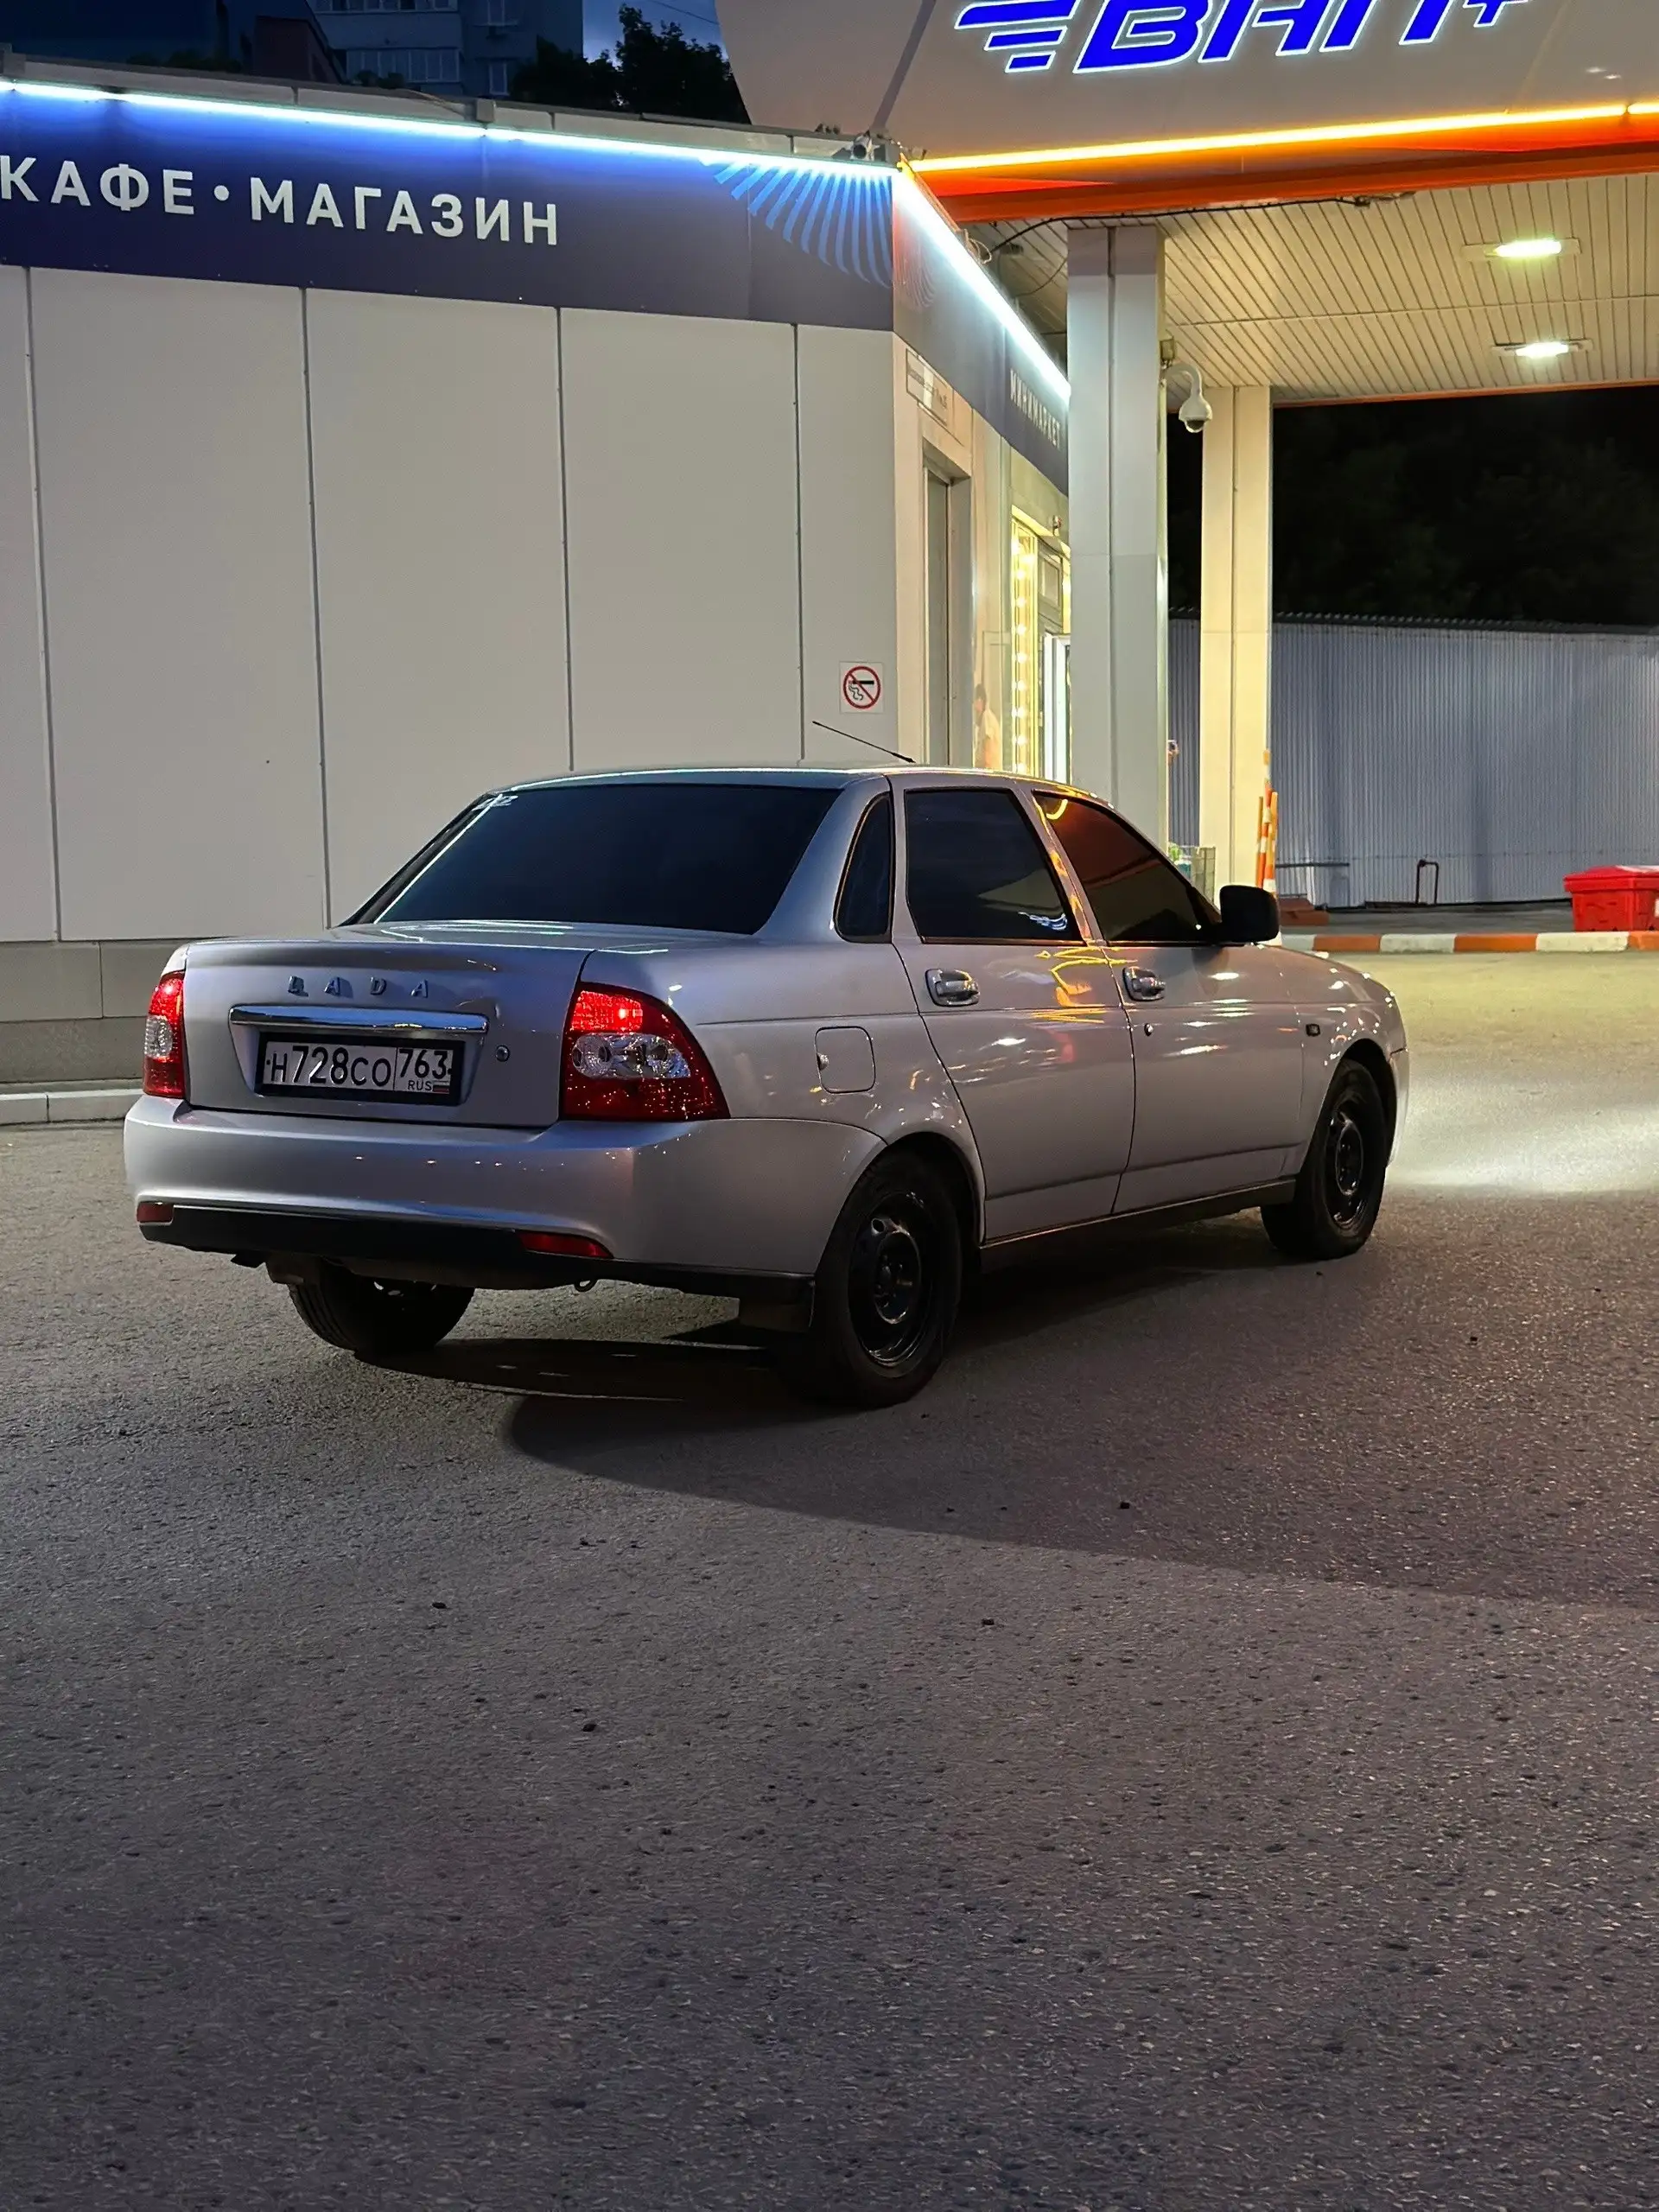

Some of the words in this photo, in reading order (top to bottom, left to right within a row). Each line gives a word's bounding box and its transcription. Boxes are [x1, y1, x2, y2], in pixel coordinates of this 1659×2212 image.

[0, 155, 195, 215] КАФЕ
[250, 176, 557, 245] МАГАЗИН
[287, 976, 429, 999] LADA
[398, 1048, 448, 1079] 763
[407, 1080, 432, 1091] RUS
